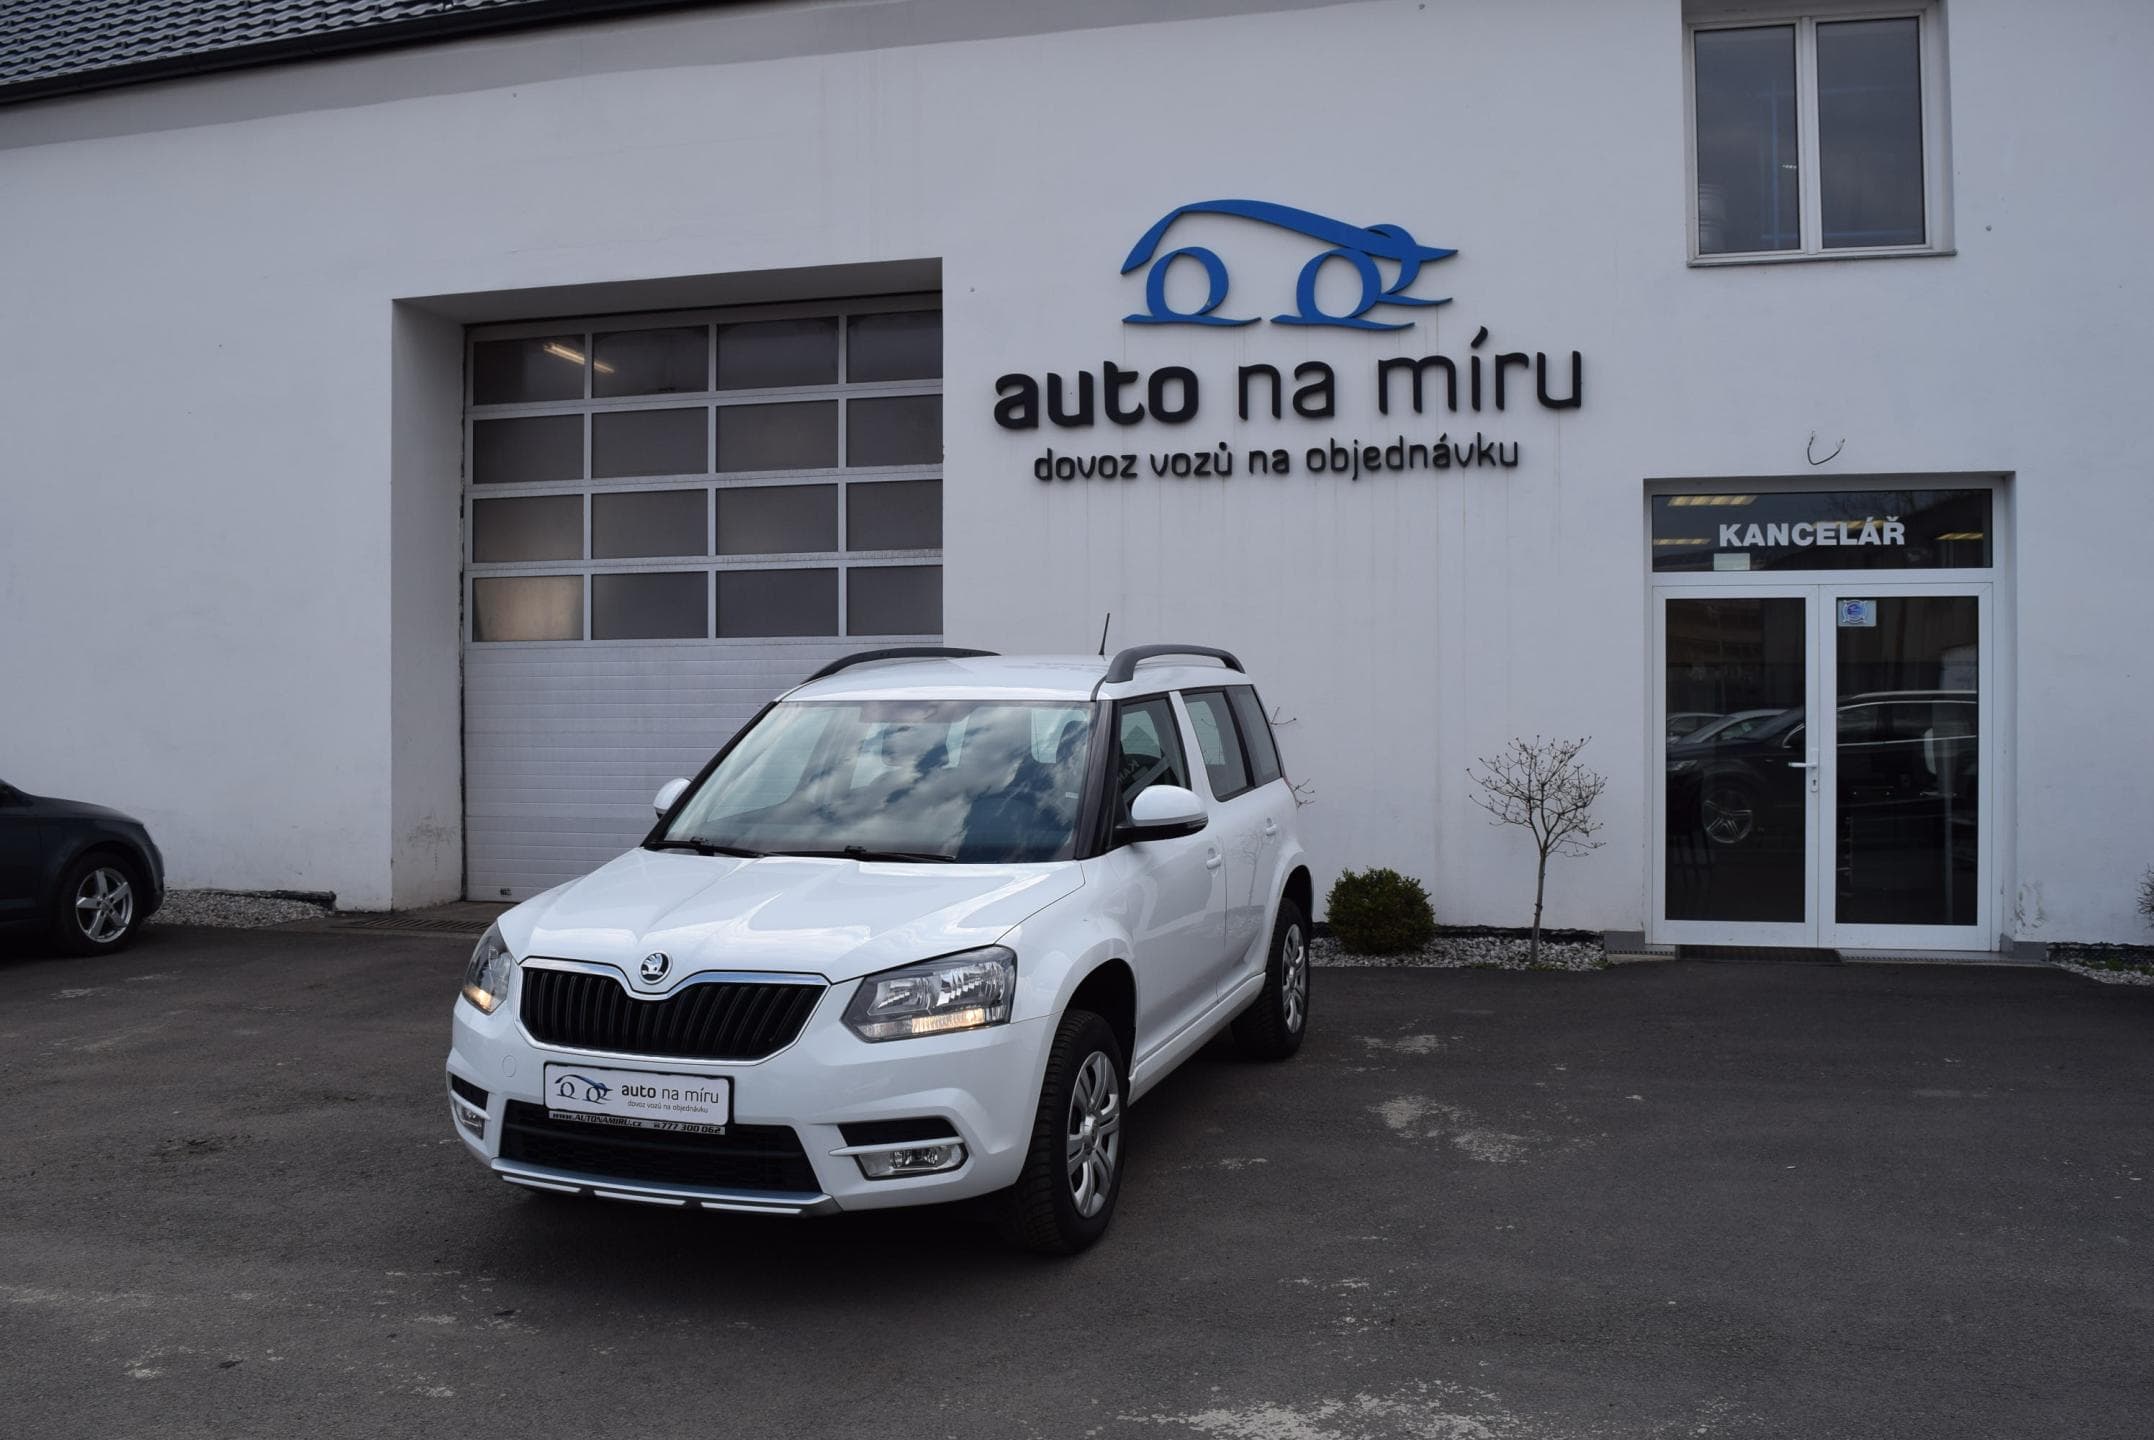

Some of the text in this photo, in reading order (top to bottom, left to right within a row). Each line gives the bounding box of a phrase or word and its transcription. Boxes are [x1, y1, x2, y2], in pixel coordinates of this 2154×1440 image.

[994, 326, 1583, 431] auto na míru
[1034, 432, 1519, 482] dovoz vozů na objednávku
[1718, 516, 1906, 547] KANCELÁŘ
[621, 1084, 719, 1104] auto na míru
[627, 1100, 646, 1108] dovoz
[660, 1120, 679, 1130] 777
